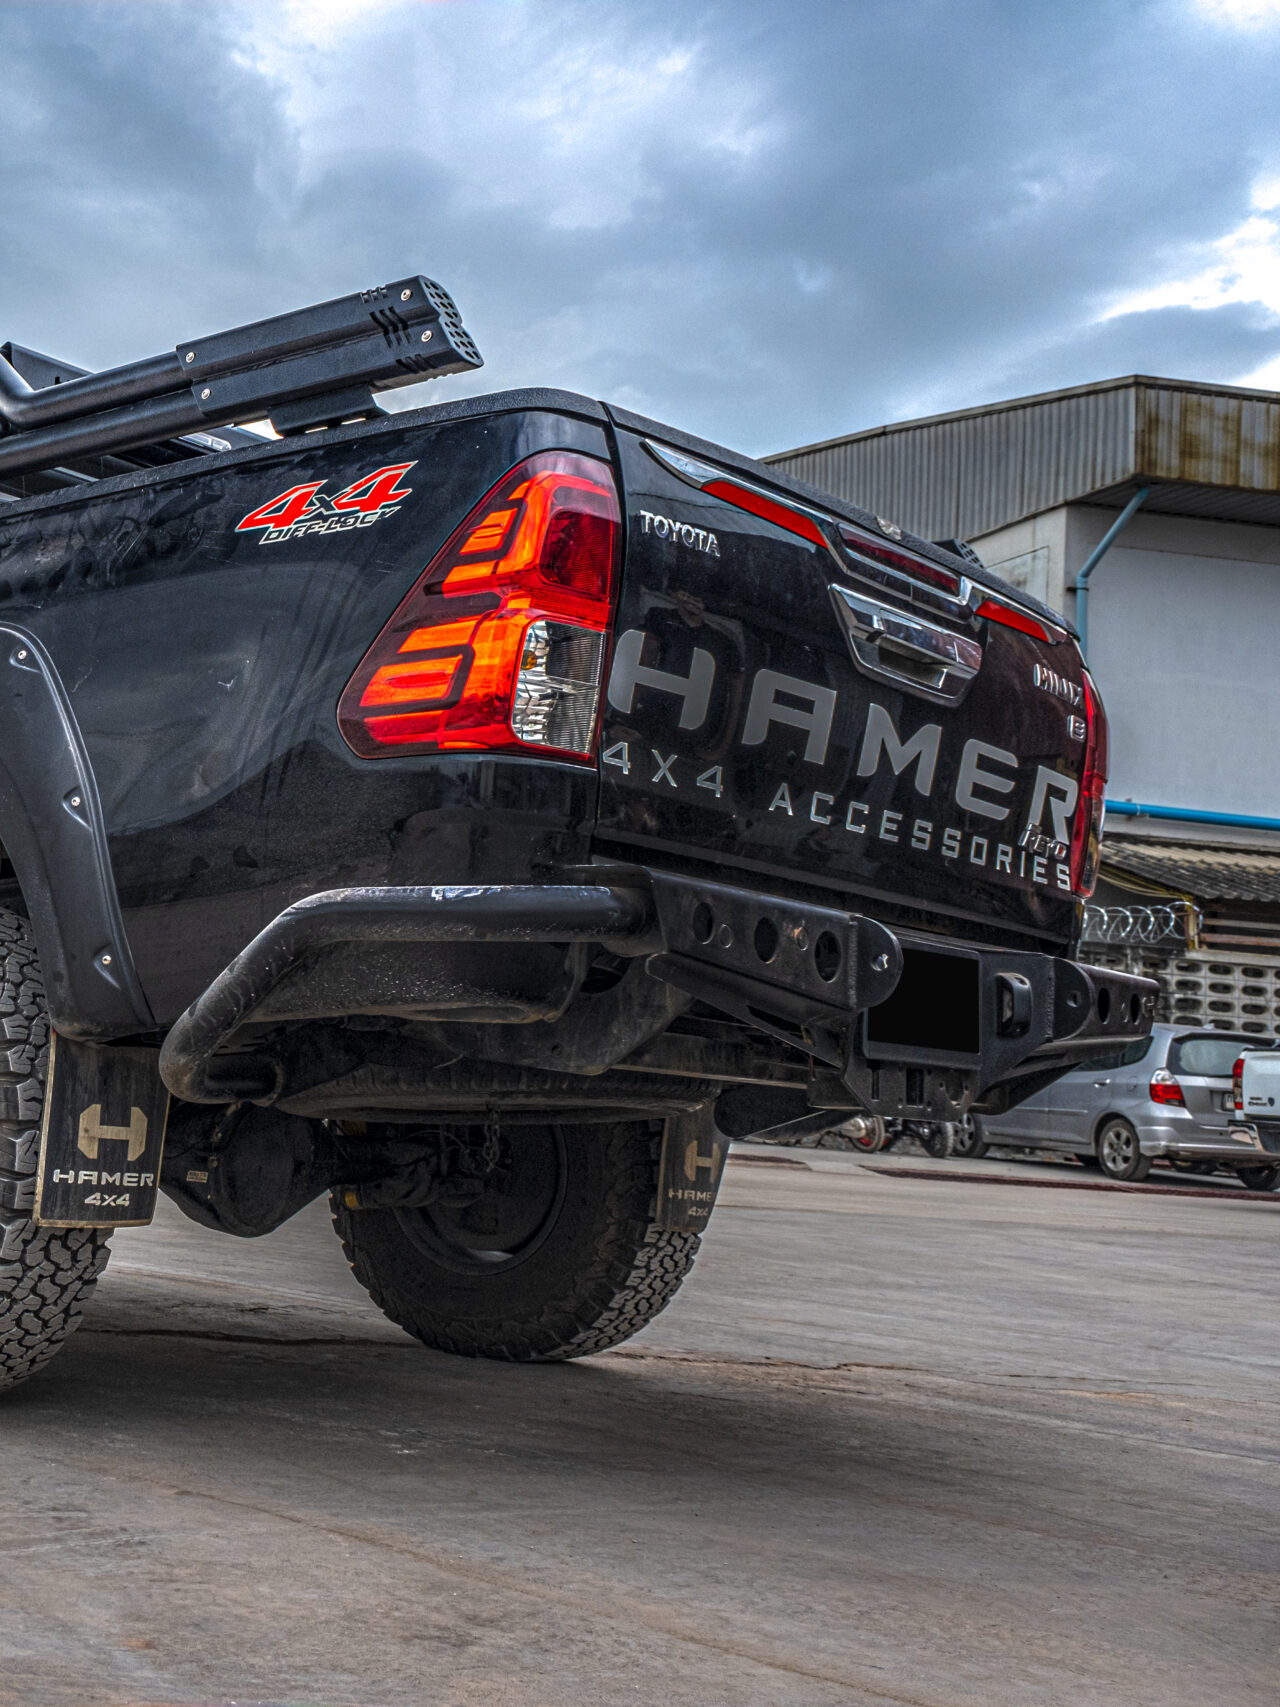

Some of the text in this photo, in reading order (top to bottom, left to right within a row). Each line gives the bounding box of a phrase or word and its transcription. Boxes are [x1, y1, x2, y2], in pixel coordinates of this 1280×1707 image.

[259, 506, 402, 545] DIFF-LOCK
[639, 509, 721, 557] TOYOTA
[607, 628, 1079, 846] HAMER
[768, 782, 1072, 891] ACCESSORIES
[52, 1168, 155, 1187] HAMER
[668, 1188, 714, 1202] HAME
